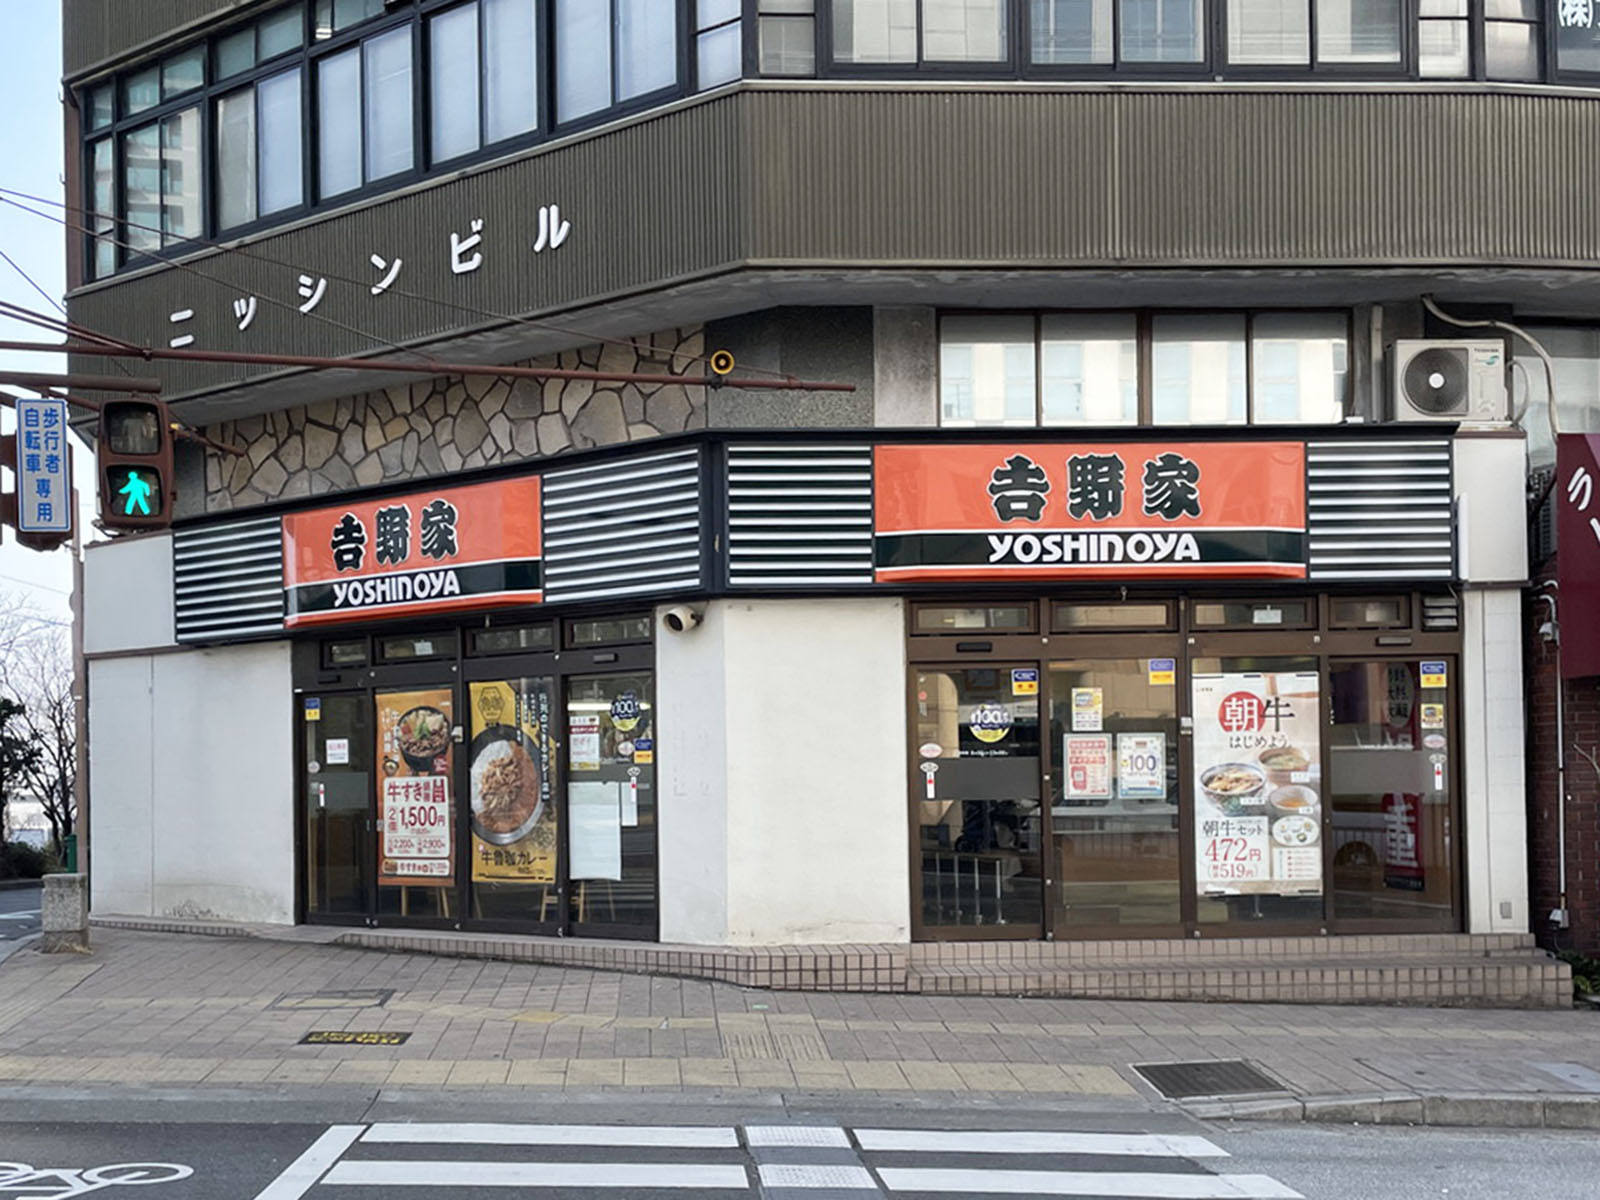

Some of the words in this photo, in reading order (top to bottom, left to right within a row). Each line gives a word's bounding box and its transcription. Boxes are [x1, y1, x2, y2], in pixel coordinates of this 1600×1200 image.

[170, 204, 570, 348] ニッシンビル
[25, 408, 41, 473] 自転車
[42, 408, 60, 474] 歩行者
[35, 478, 52, 523] 専用
[988, 533, 1201, 564] YOSHINOYA
[333, 570, 460, 608] YOSHINOYA
[1222, 696, 1295, 733] 朝牛
[1205, 838, 1262, 862] 472円
